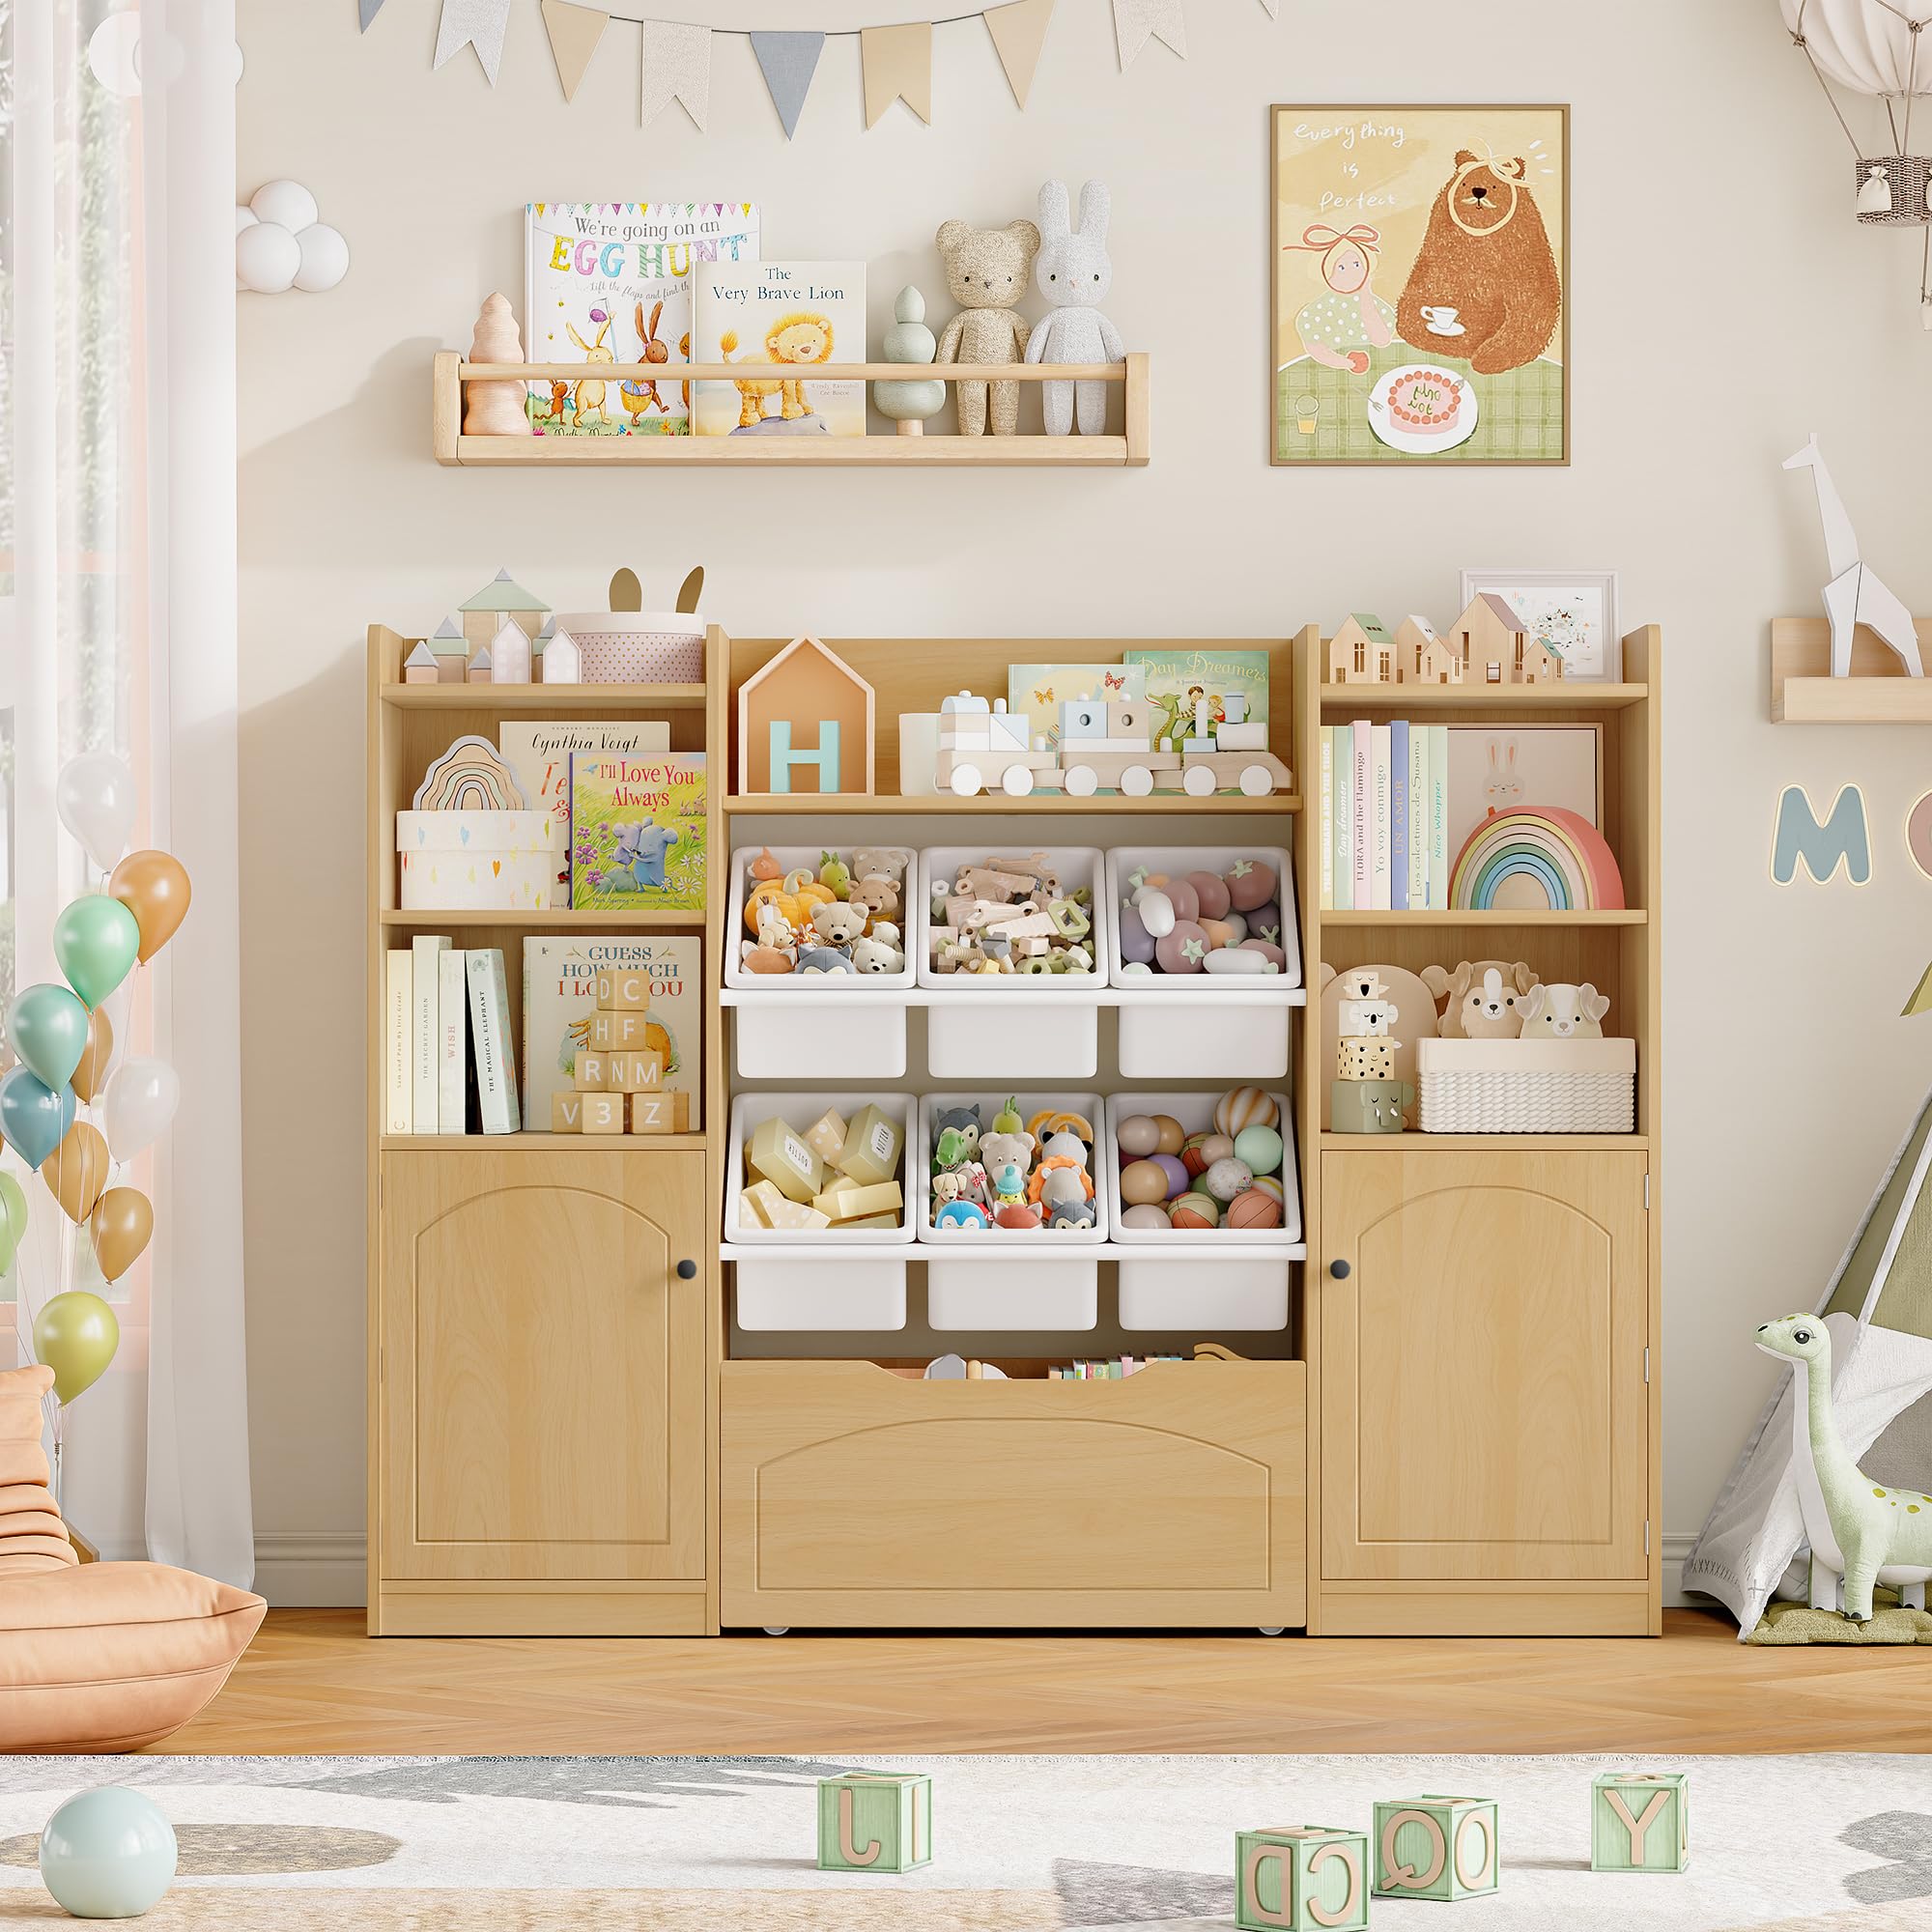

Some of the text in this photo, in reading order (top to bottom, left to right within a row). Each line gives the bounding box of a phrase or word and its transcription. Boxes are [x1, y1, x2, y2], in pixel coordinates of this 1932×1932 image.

[1342, 161, 1358, 179] is
[575, 216, 721, 242] We're going on an
[549, 233, 748, 278] EGG HUNT
[765, 267, 792, 280] The
[609, 280, 619, 291] the
[622, 285, 644, 300] flaps
[645, 289, 661, 299] and
[663, 284, 679, 300] find
[680, 280, 689, 291] th
[713, 286, 844, 305] Very Brave Lion
[1184, 651, 1267, 681] Dreamers
[532, 732, 639, 756] Cynthia Voigt
[770, 720, 840, 793] H
[600, 760, 695, 785] I'll Love You
[1355, 751, 1366, 802] Flamingo
[611, 785, 670, 812] Always
[1336, 780, 1351, 858] Day dreamers
[1355, 804, 1364, 821] the
[1376, 764, 1387, 874] Yo voy conmigo
[1395, 779, 1404, 856] UN AMOR
[1411, 740, 1422, 896] Los calcetines de Susana
[1434, 780, 1443, 859] Nico Whopper
[1355, 824, 1364, 844] and
[588, 946, 652, 961] GUESS
[557, 980, 683, 997] I LO OU
[600, 978, 610, 1000] D
[623, 978, 640, 1002] C
[479, 990, 489, 1033] ELEPHANT
[595, 1019, 609, 1041] H
[623, 1018, 635, 1041] F
[484, 1037, 494, 1072] MAGICAL
[584, 1060, 602, 1082] R
[611, 1060, 624, 1083] N
[636, 1062, 657, 1084] M
[561, 1102, 580, 1125] V
[596, 1101, 611, 1125] 3
[644, 1102, 661, 1124] Z
[1603, 1789, 1671, 1865] Y
